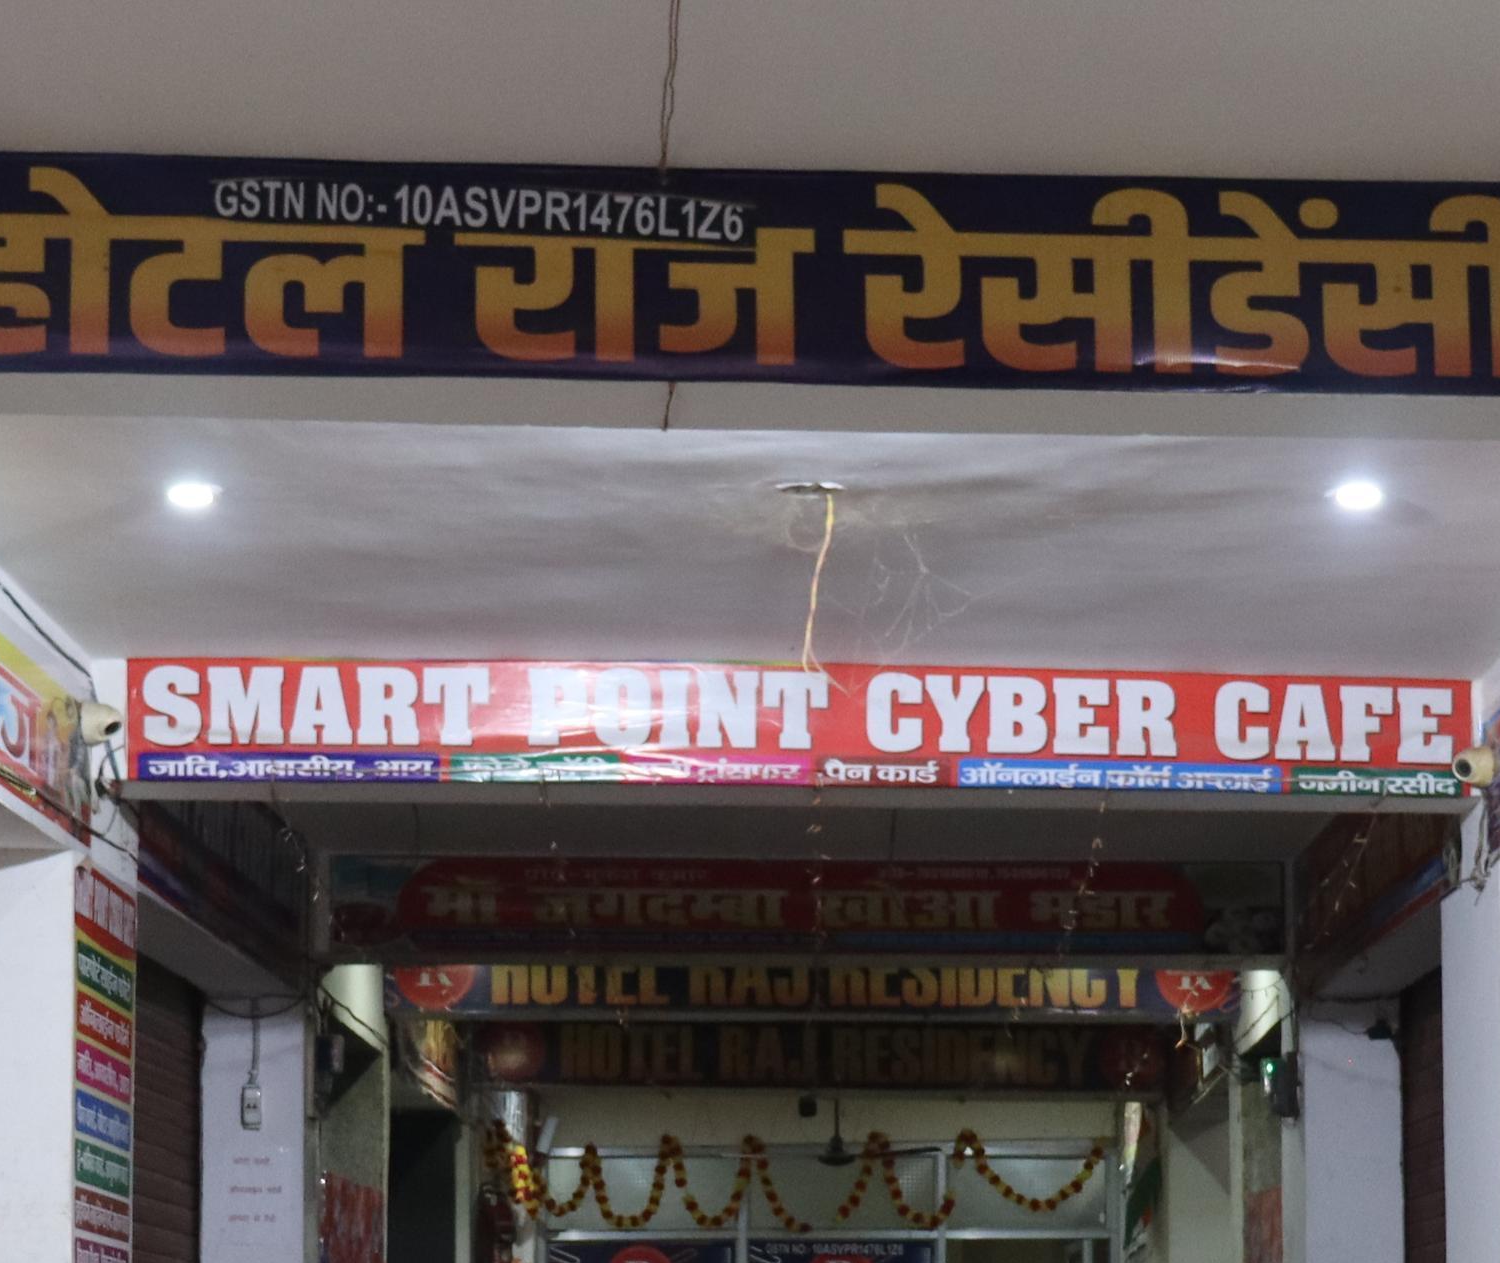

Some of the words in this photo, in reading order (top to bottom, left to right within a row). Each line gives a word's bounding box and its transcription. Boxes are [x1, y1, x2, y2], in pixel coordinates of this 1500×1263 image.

[214, 181, 302, 219] GSTN
[399, 185, 745, 242] 10ASVPR1476L1Z6
[455, 225, 815, 366] राज
[142, 664, 490, 747] SMART
[527, 667, 829, 751] POINT
[864, 672, 1178, 757] CYBER
[1214, 680, 1454, 764] CAFE
[824, 758, 872, 782] पैन
[877, 762, 941, 784] कार्ड
[959, 760, 1100, 788] ऑनलाईन
